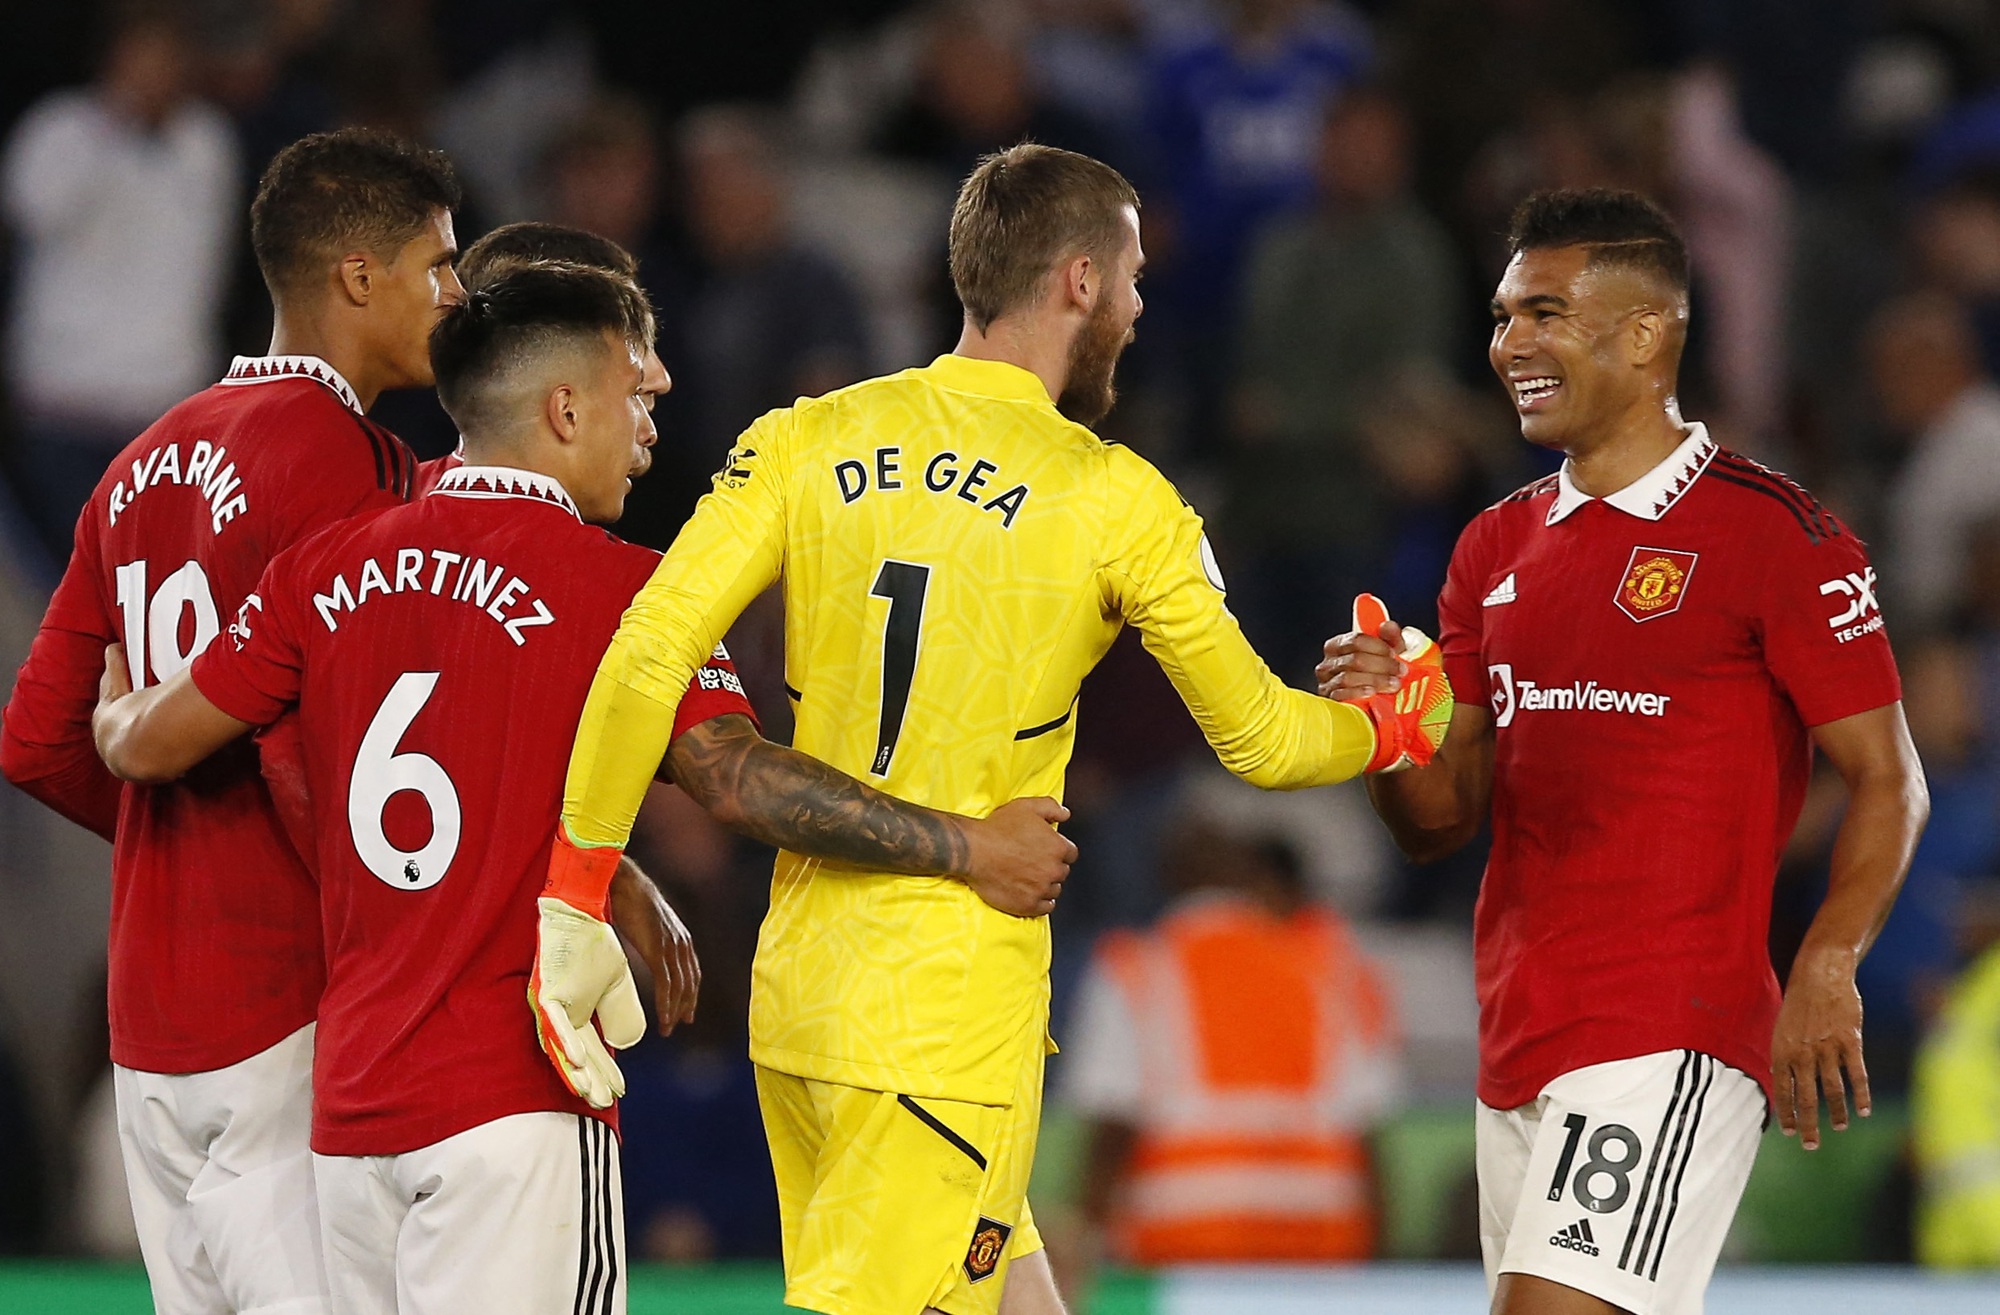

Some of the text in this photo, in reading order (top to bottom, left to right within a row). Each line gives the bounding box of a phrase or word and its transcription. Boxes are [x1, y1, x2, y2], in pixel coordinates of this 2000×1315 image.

[834, 446, 1029, 530] DE GEA
[312, 548, 556, 647] MARTINEZ
[870, 560, 930, 777] 1
[1516, 680, 1671, 717] TeamViewer
[347, 671, 462, 891] 6
[1547, 1112, 1642, 1214] 18
[1549, 1236, 1599, 1256] adidas
